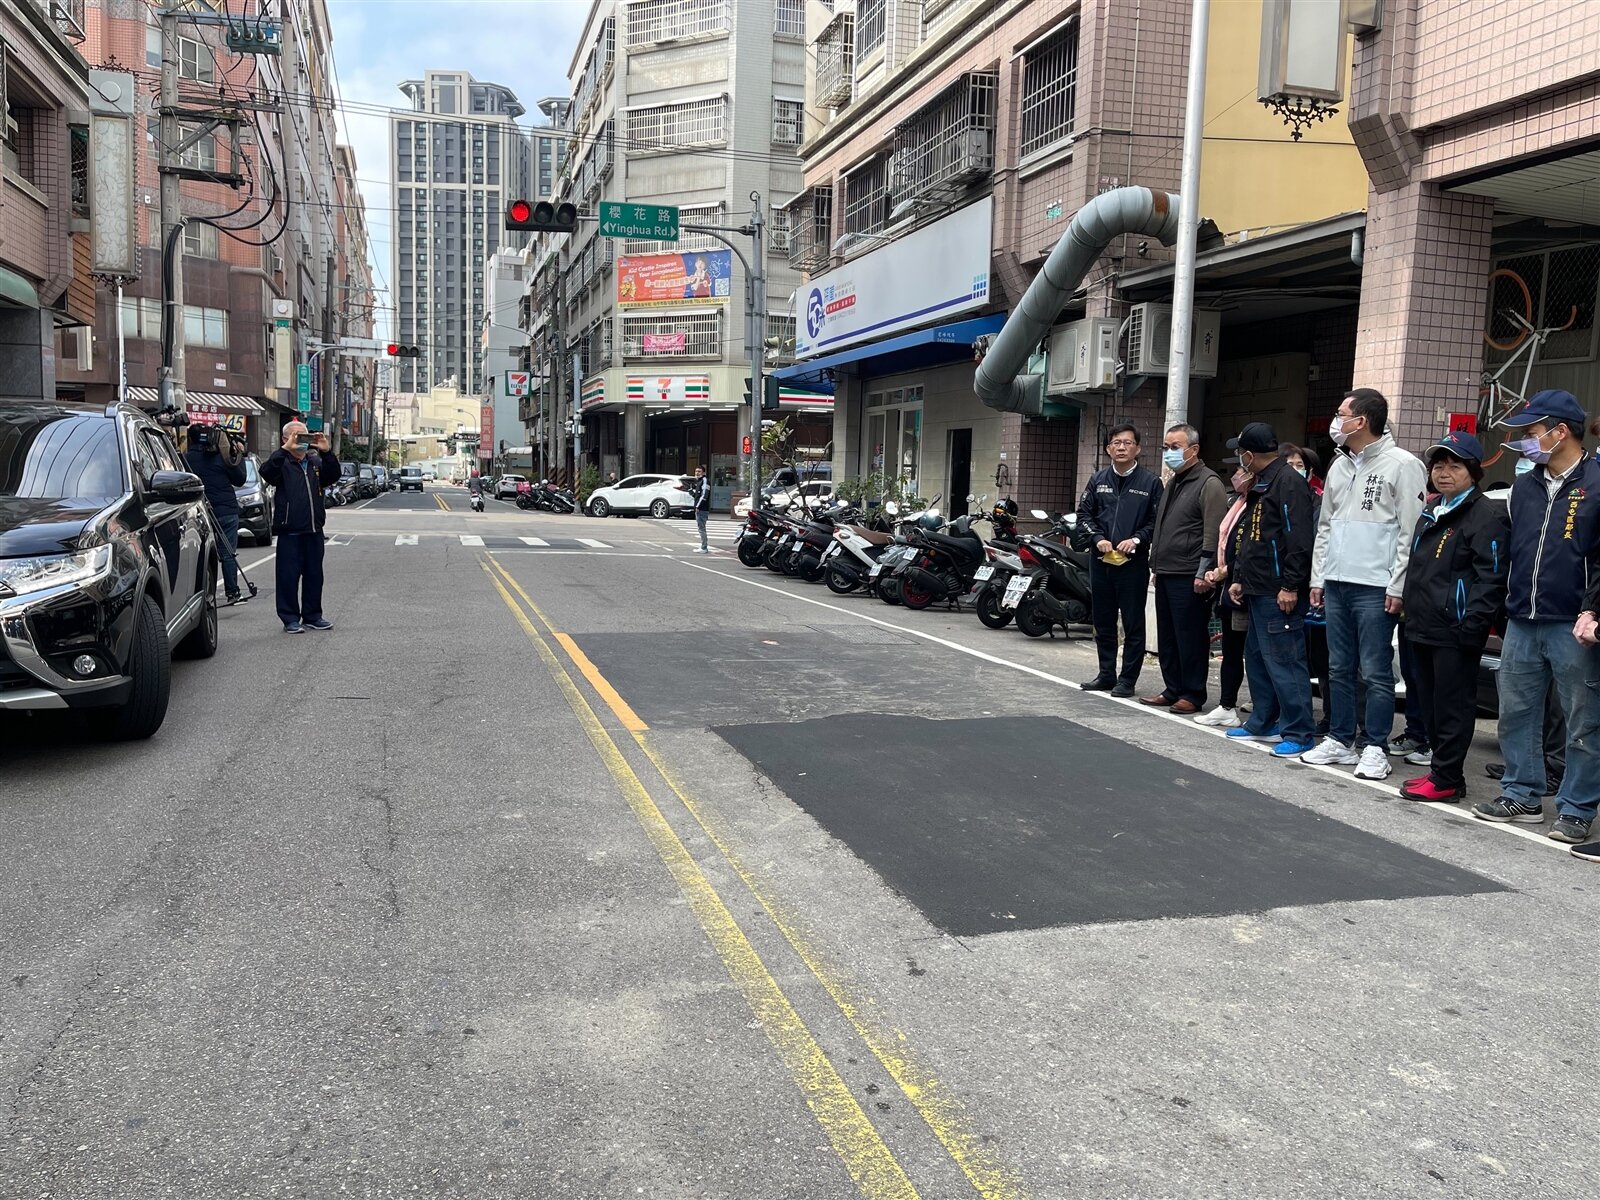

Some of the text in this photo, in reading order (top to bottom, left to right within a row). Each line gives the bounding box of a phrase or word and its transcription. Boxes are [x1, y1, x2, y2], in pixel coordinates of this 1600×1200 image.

[608, 205, 671, 222] 櫻花路
[609, 223, 670, 238] Yinghua Rd.
[226, 415, 243, 431] 45
[1360, 473, 1378, 512] 林祈烽
